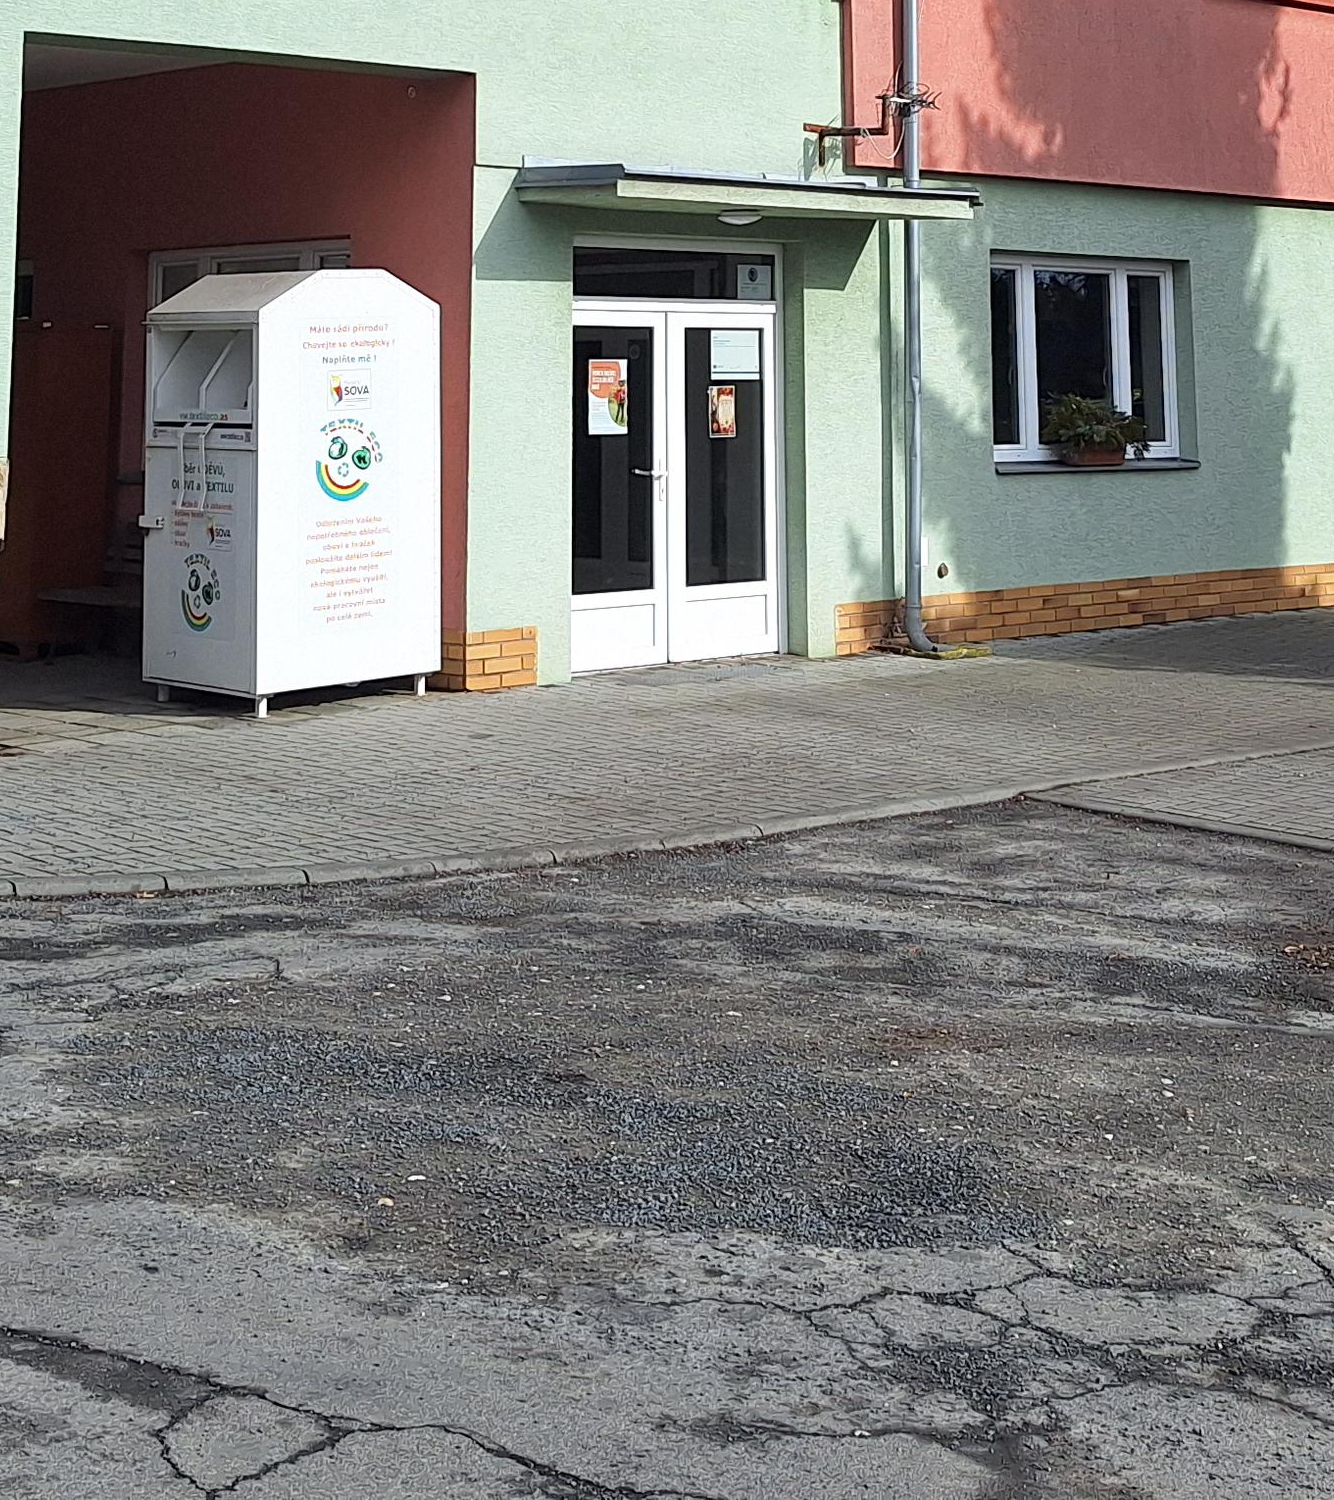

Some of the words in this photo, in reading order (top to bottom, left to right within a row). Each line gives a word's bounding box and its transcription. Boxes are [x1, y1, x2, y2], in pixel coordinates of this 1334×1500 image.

[322, 354, 356, 365] Naplňte
[344, 385, 370, 396] SOVA
[205, 481, 234, 494] EXTILU
